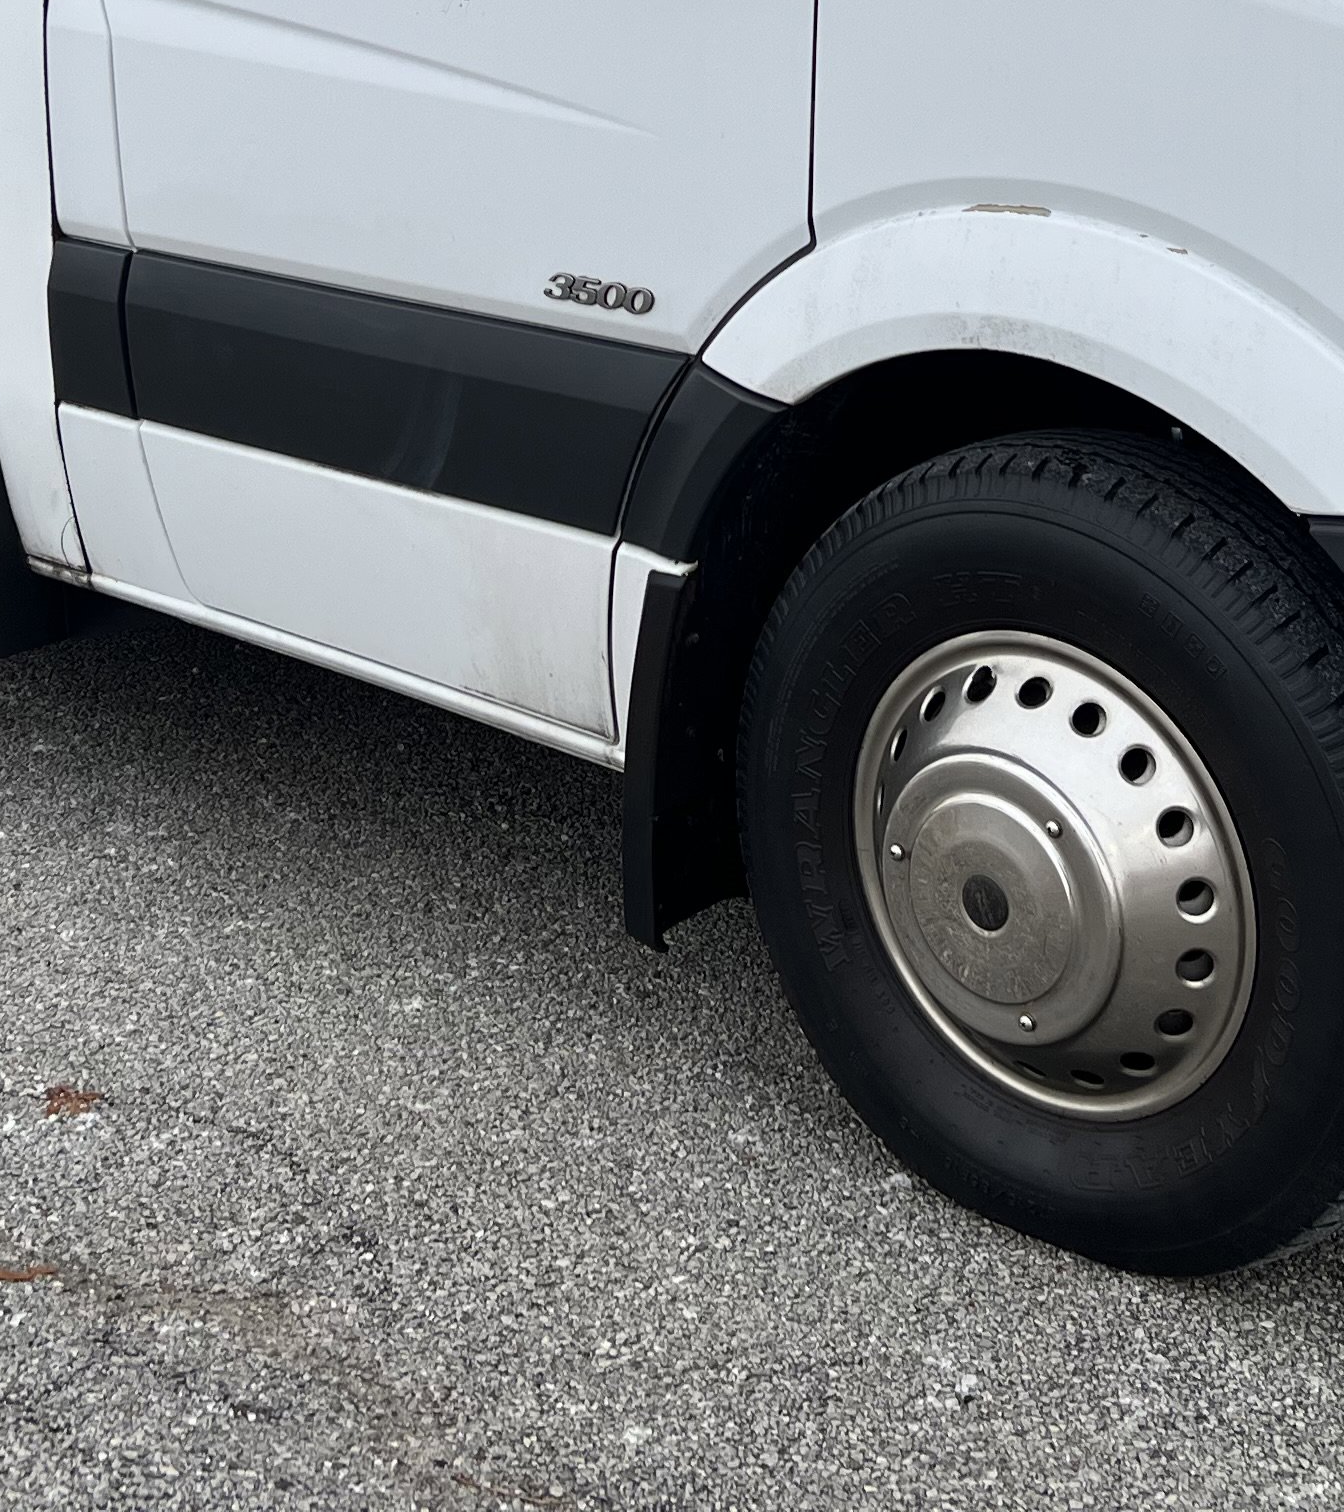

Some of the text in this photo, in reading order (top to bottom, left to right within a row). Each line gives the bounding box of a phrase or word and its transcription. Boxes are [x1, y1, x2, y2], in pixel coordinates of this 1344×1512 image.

[543, 272, 655, 315] 3500
[792, 592, 917, 972] WRANGLER
[1071, 837, 1301, 1193] GOODYEAR
